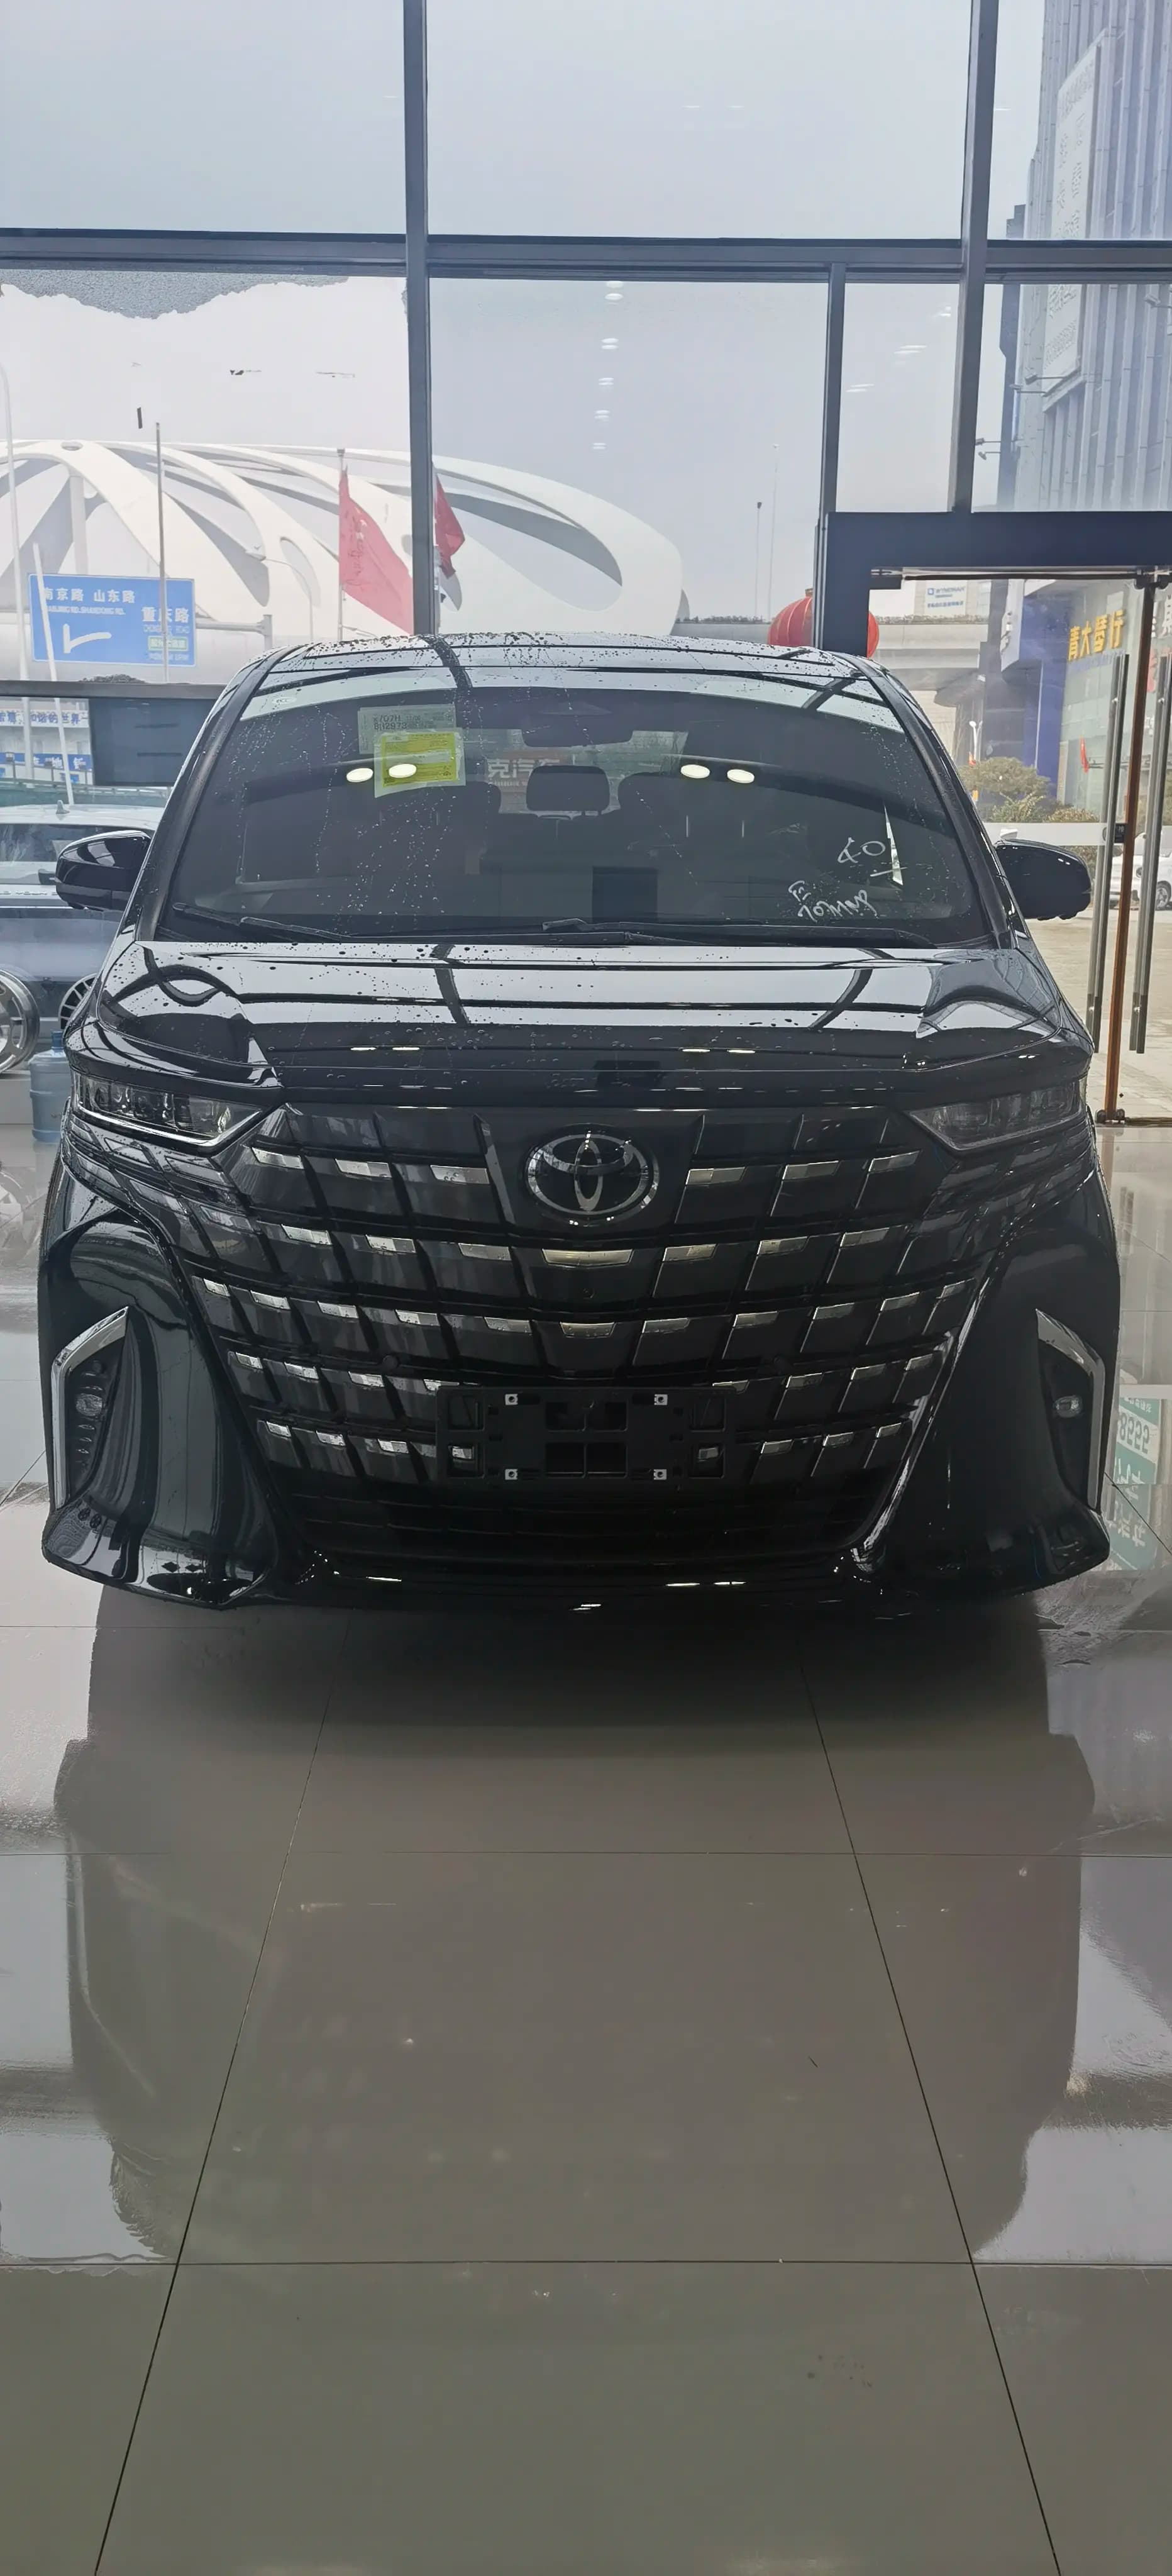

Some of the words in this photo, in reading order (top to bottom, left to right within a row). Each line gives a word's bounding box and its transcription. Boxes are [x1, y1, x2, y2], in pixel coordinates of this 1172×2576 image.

[93, 589, 136, 604] 山东路
[1068, 609, 1124, 662] 青大琴行
